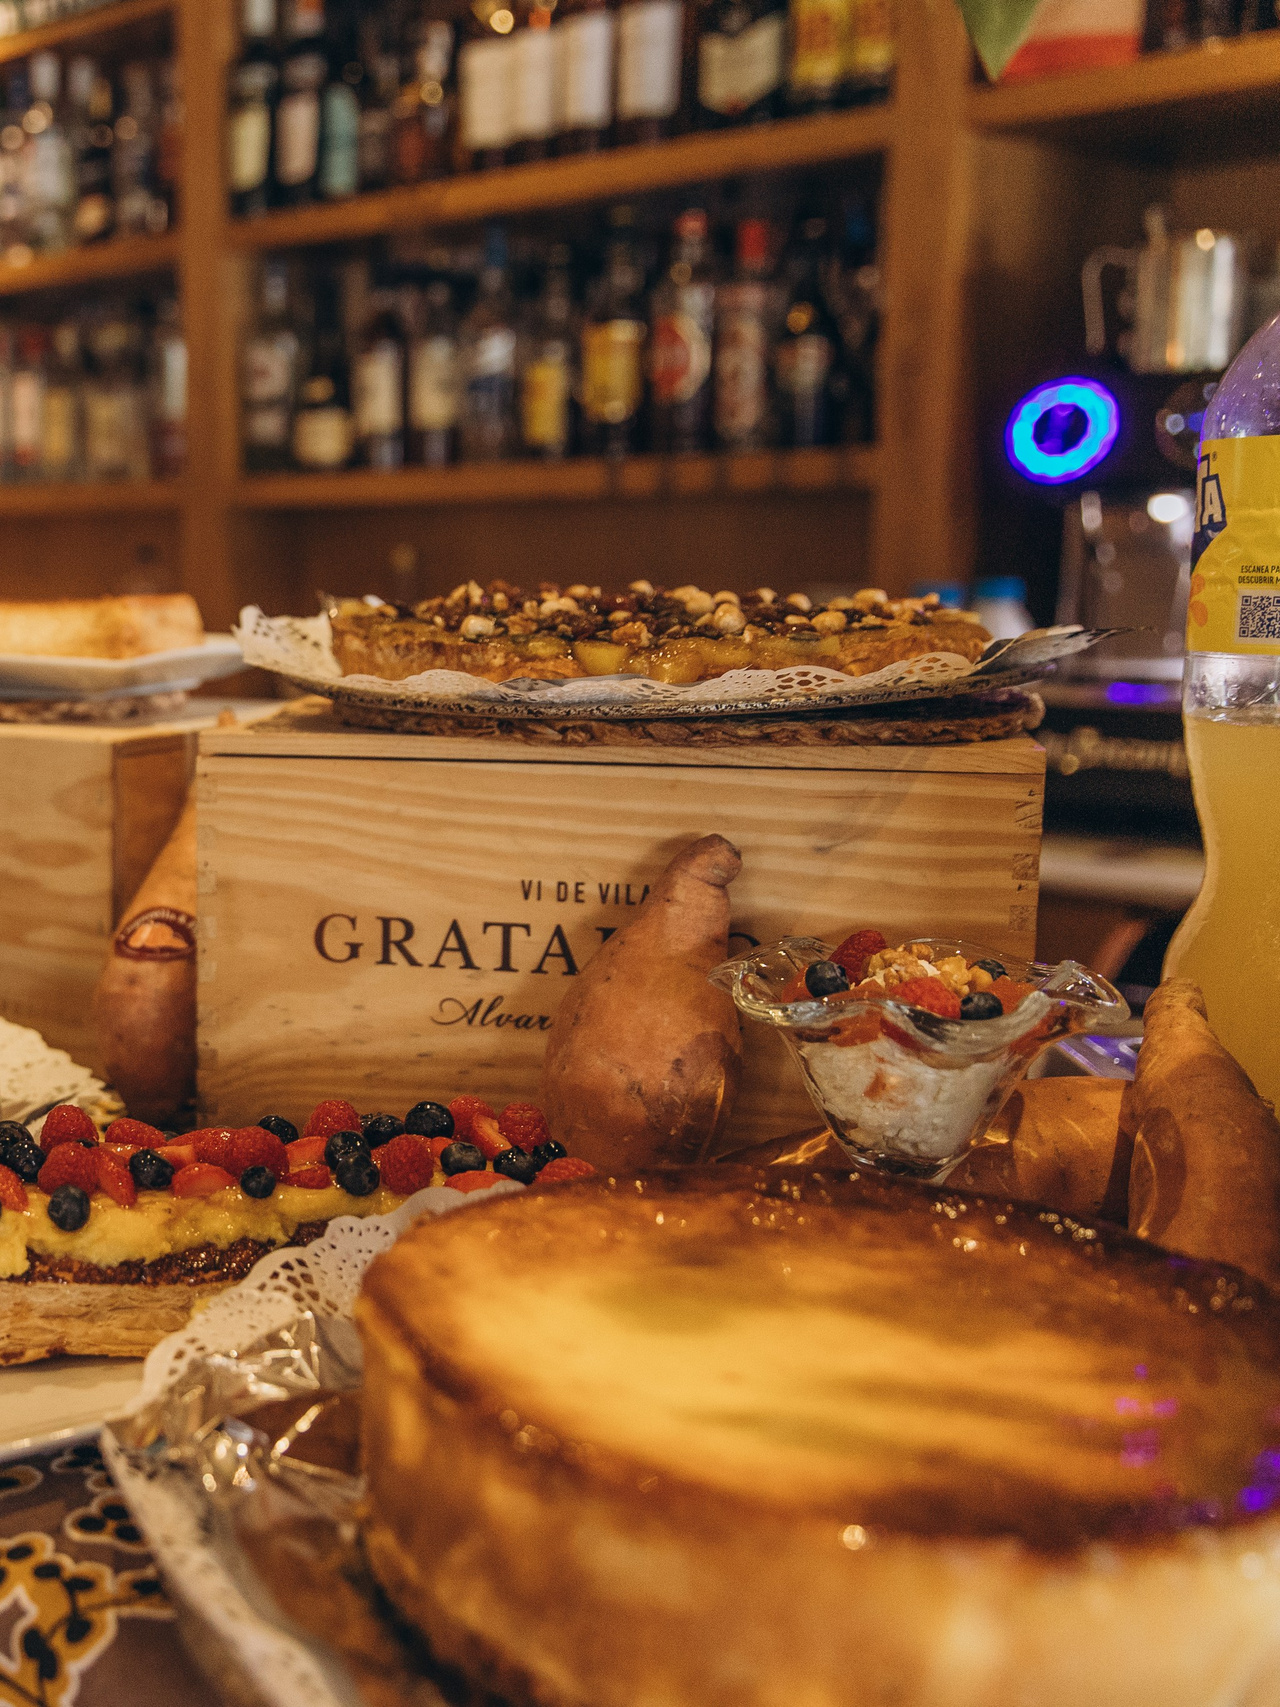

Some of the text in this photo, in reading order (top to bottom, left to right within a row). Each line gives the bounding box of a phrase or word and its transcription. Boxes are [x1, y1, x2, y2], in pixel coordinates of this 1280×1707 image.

[1241, 564, 1269, 573] ESCANEA
[1238, 576, 1274, 584] DESCUBRIR
[521, 879, 542, 901] VI
[556, 881, 585, 903] DE
[314, 912, 618, 976] GRATA
